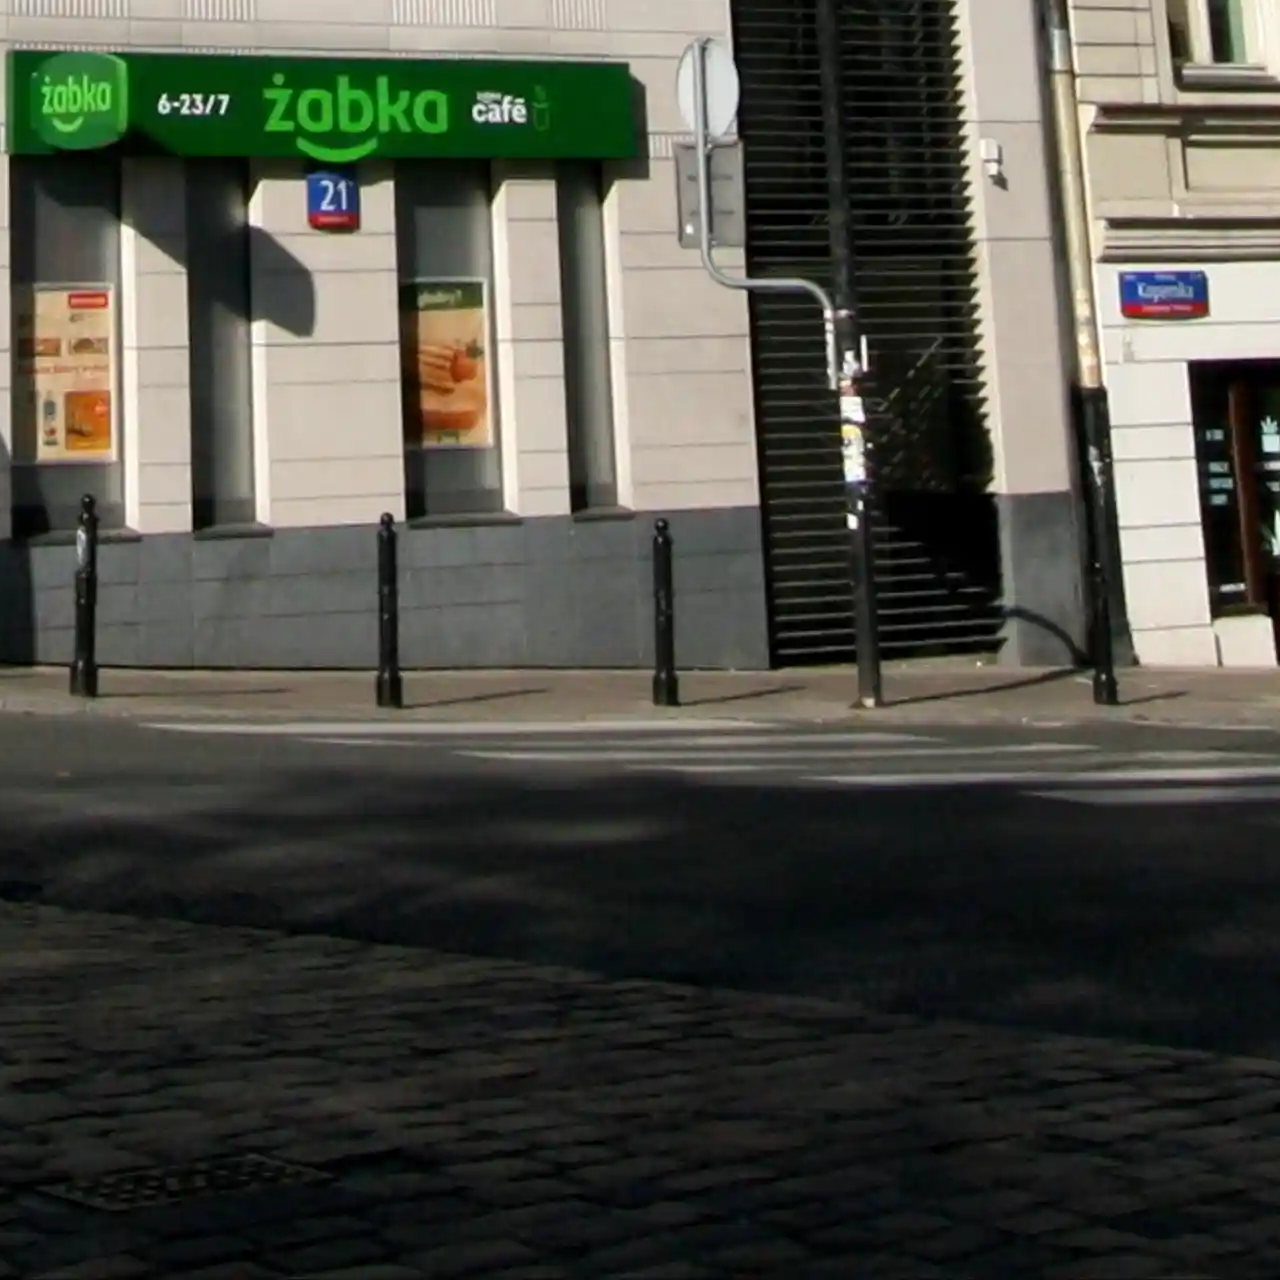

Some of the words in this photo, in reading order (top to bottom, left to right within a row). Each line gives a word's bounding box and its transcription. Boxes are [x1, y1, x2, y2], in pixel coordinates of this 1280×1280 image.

[41, 74, 112, 114] żabka
[157, 93, 231, 116] 6-23/7
[263, 72, 449, 134] żabka
[471, 95, 528, 124] café
[320, 180, 348, 211] 21
